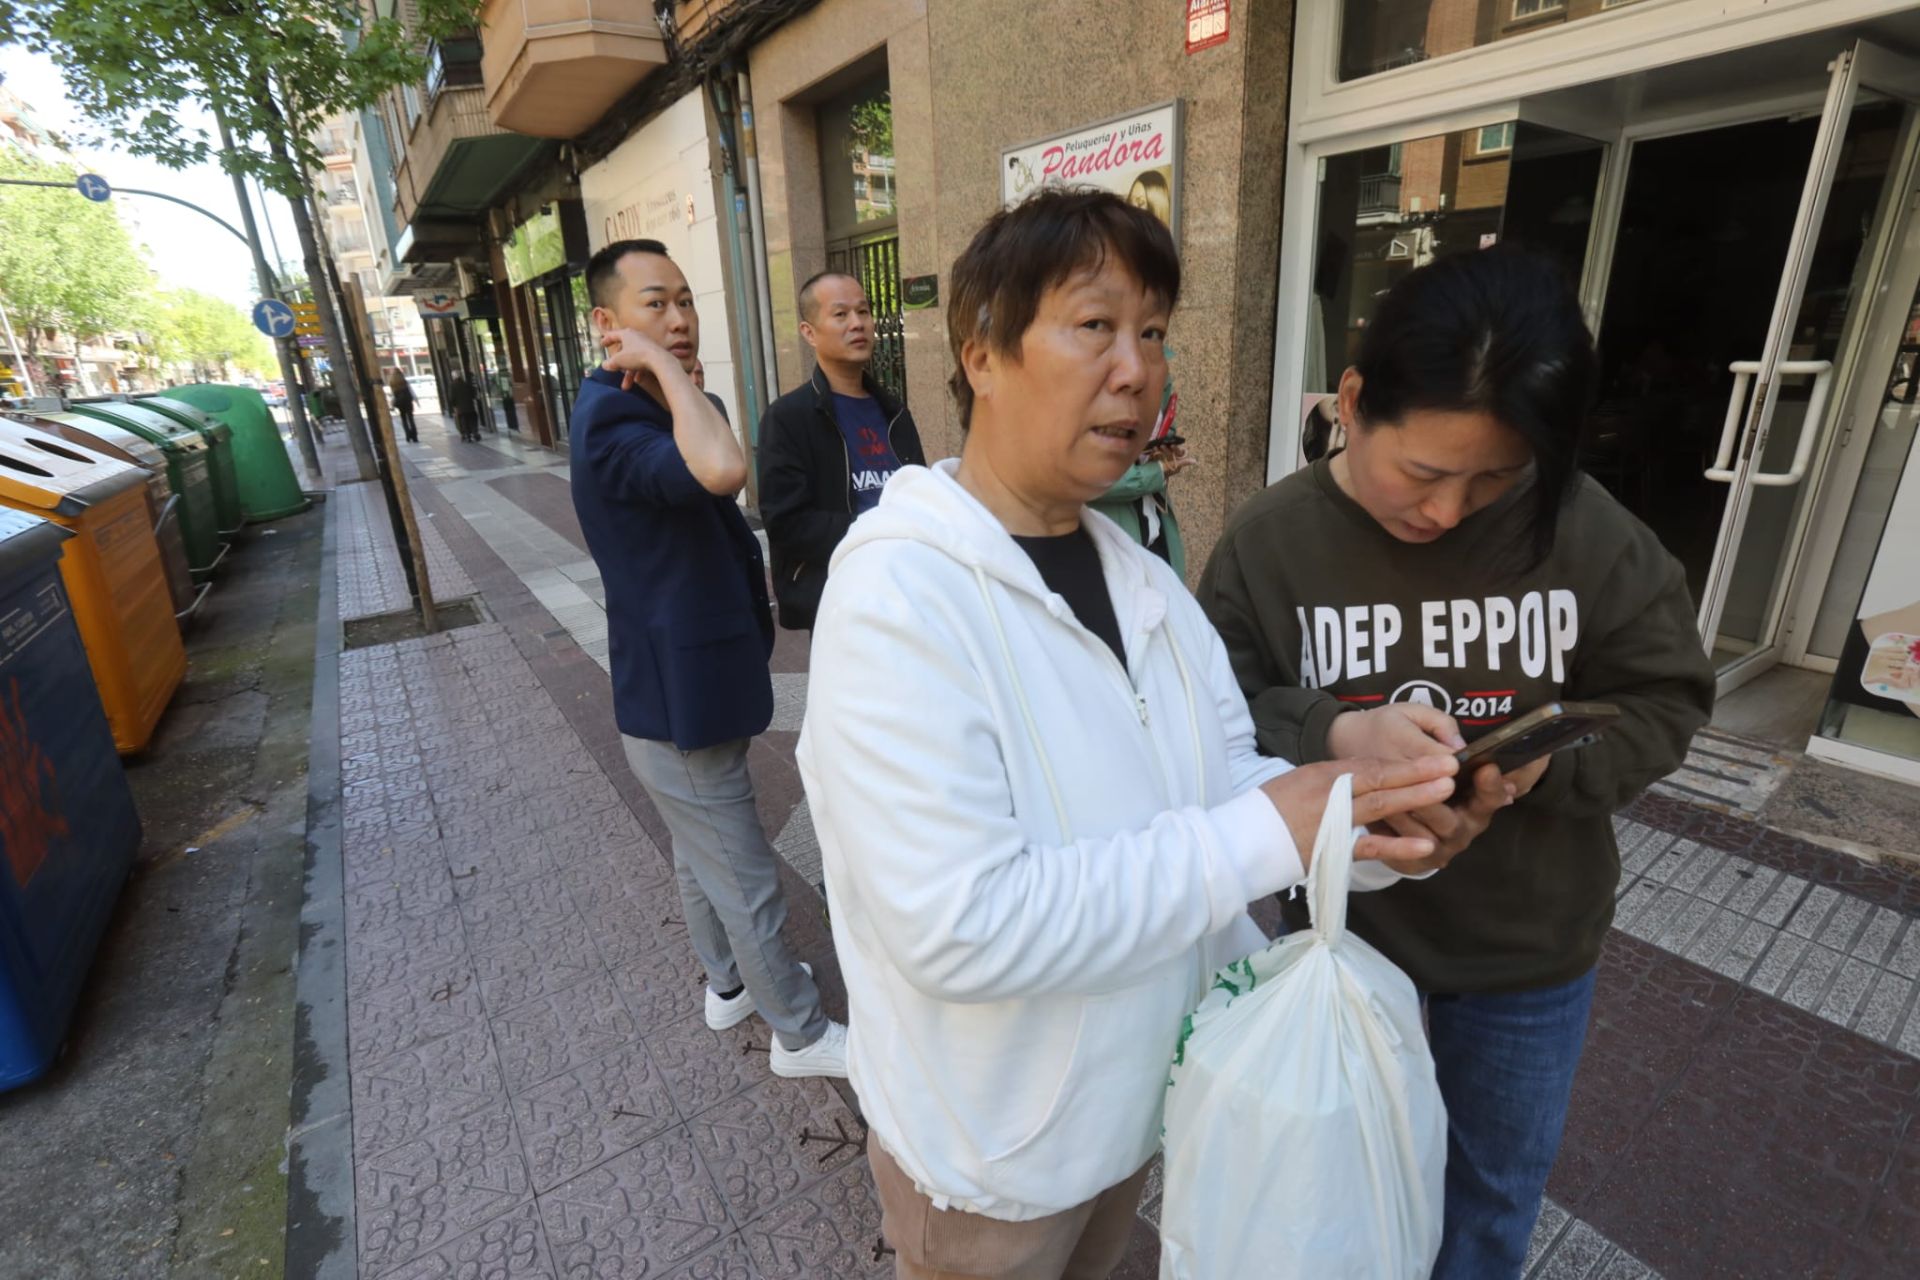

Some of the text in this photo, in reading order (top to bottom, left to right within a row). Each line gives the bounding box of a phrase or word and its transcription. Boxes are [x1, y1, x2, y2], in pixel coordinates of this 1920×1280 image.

[1065, 122, 1152, 152] Peluquería y Uñas
[1042, 132, 1165, 184] Pandora
[1421, 589, 1579, 684] EPPOP
[1454, 696, 1513, 717] 2014
